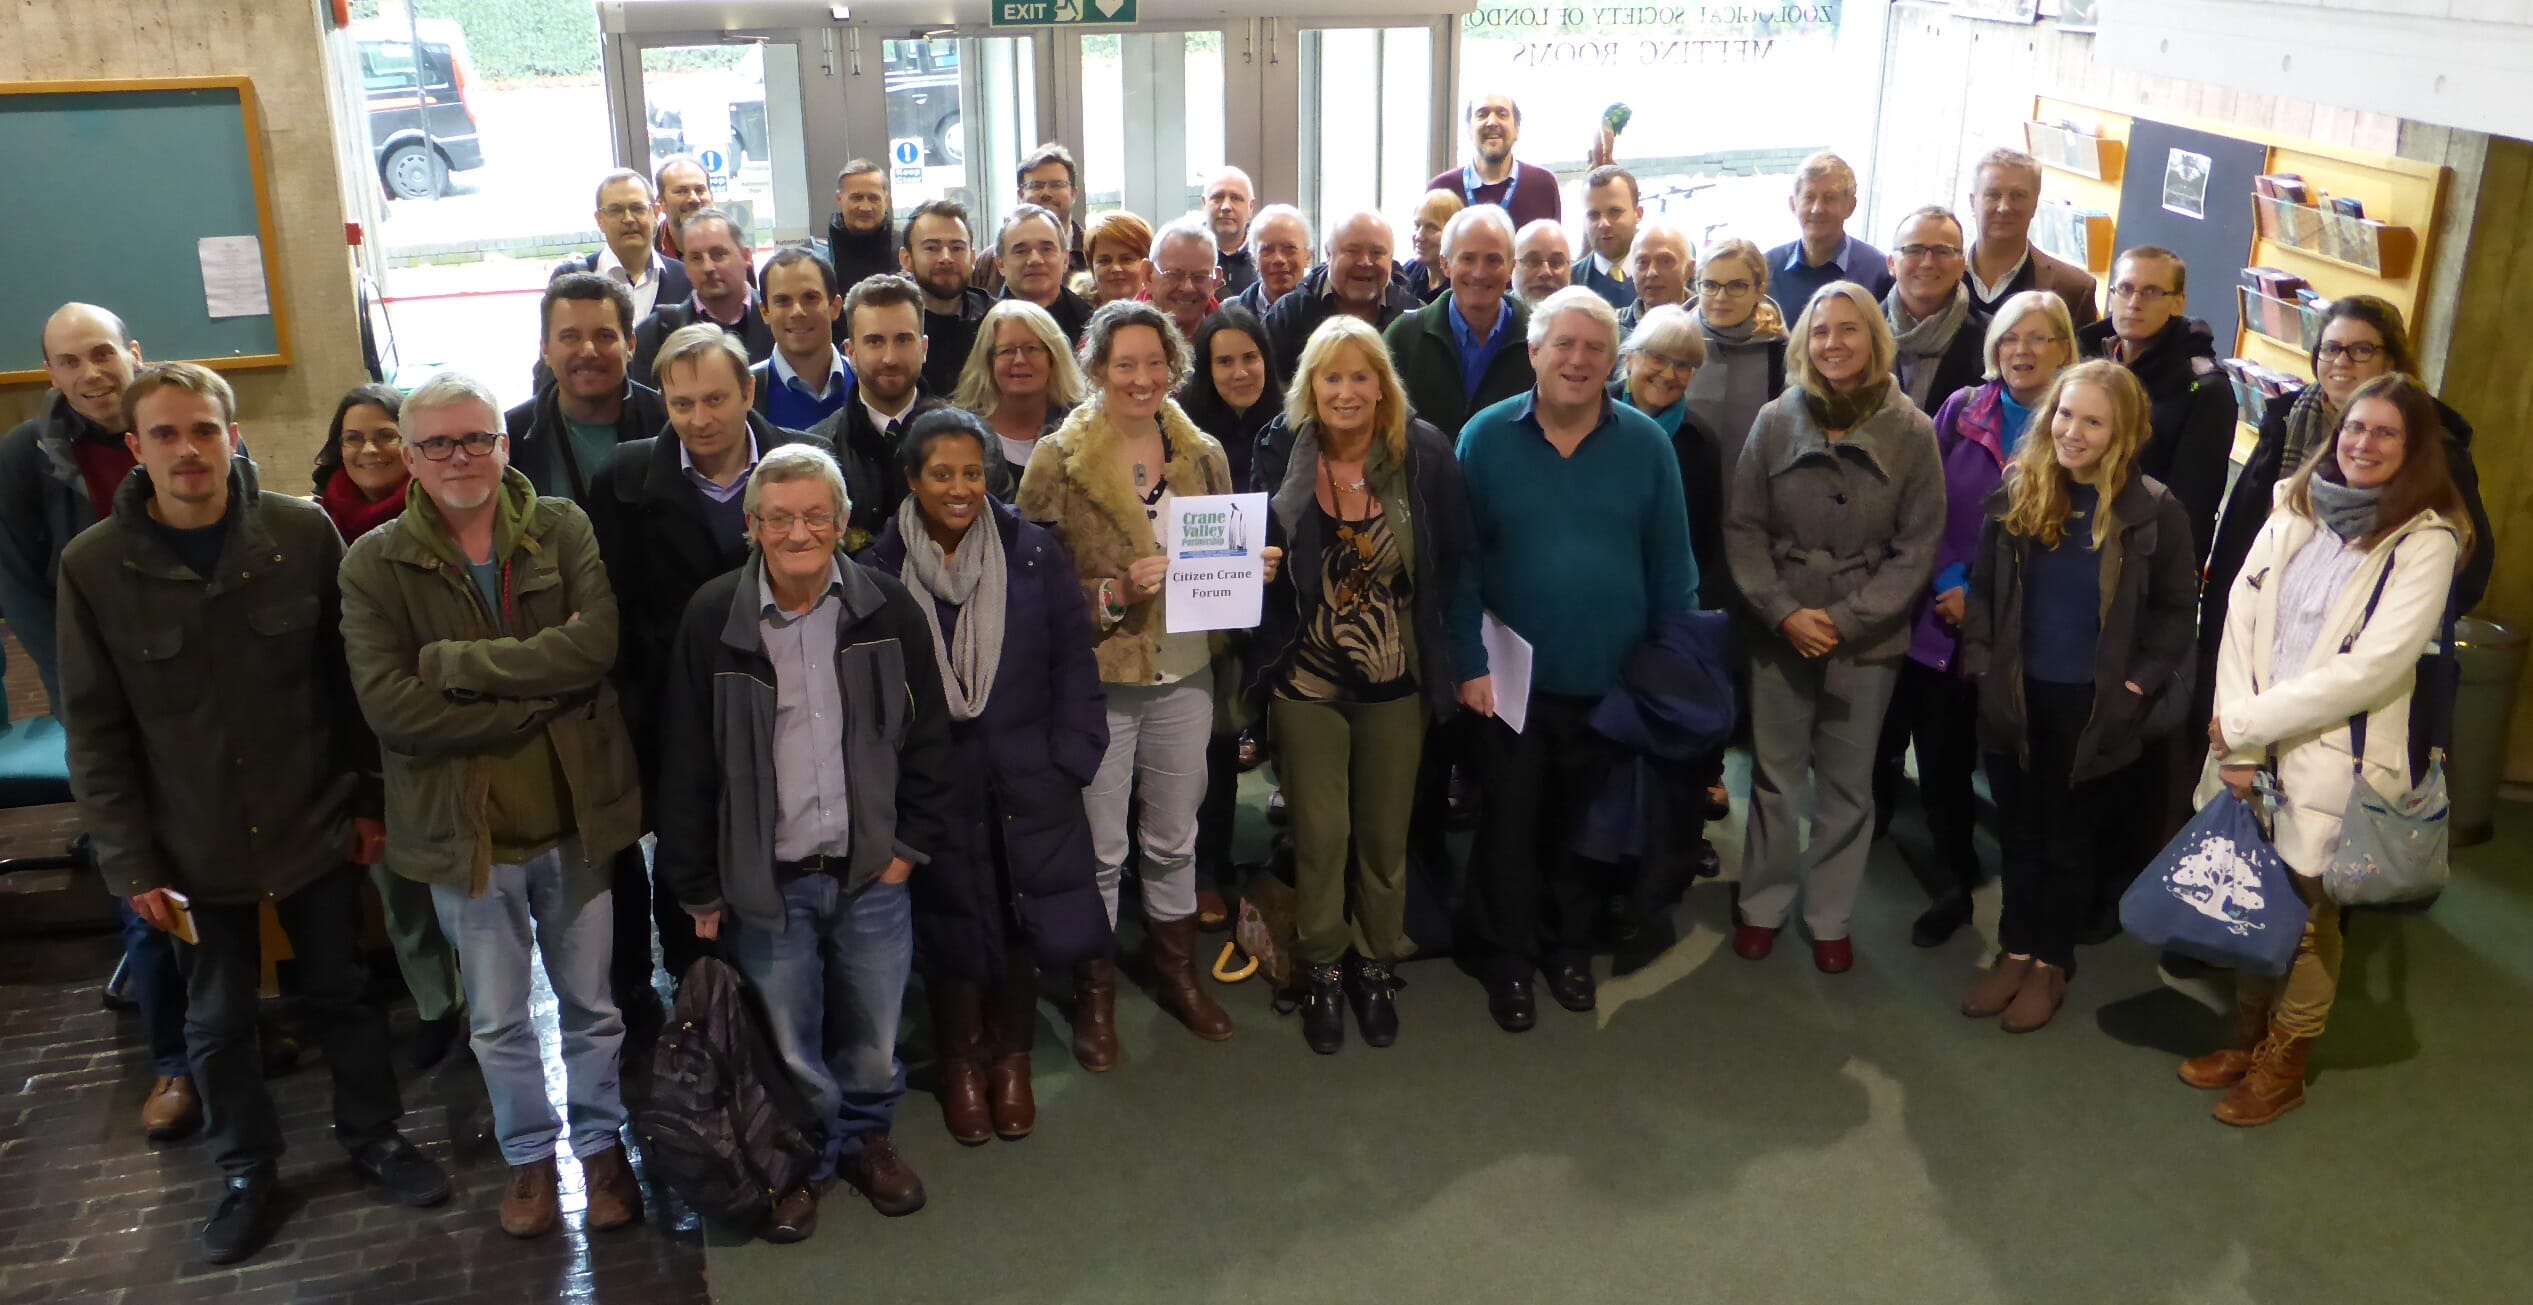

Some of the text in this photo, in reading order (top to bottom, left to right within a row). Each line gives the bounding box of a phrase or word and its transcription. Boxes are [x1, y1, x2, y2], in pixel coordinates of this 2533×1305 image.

[1004, 3, 1047, 20] EXIT
[895, 168, 921, 177] Keep
[1183, 512, 1226, 525] Crane
[1183, 525, 1225, 537] Valley
[1182, 537, 1224, 546] Partnership
[1173, 569, 1252, 582] Citizen Crane
[1192, 588, 1231, 599] Forum
